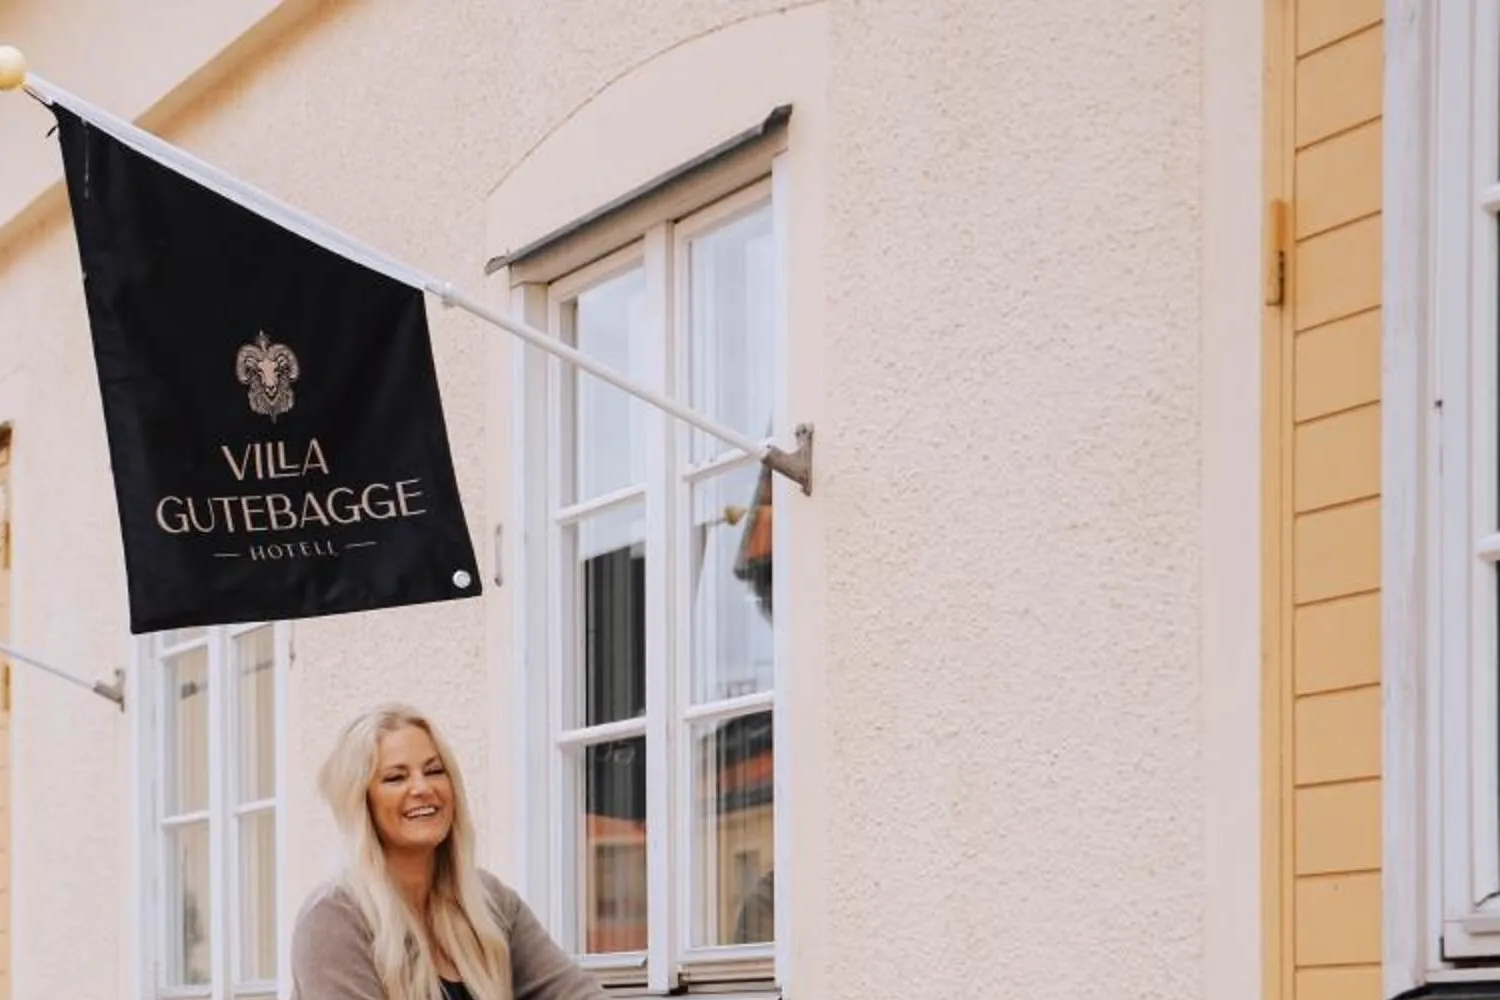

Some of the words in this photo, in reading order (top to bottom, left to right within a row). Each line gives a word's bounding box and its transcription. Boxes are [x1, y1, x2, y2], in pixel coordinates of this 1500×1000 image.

[221, 437, 329, 481] VILLA
[155, 478, 427, 533] GUTEBAGGE
[250, 540, 338, 561] HOTELL
